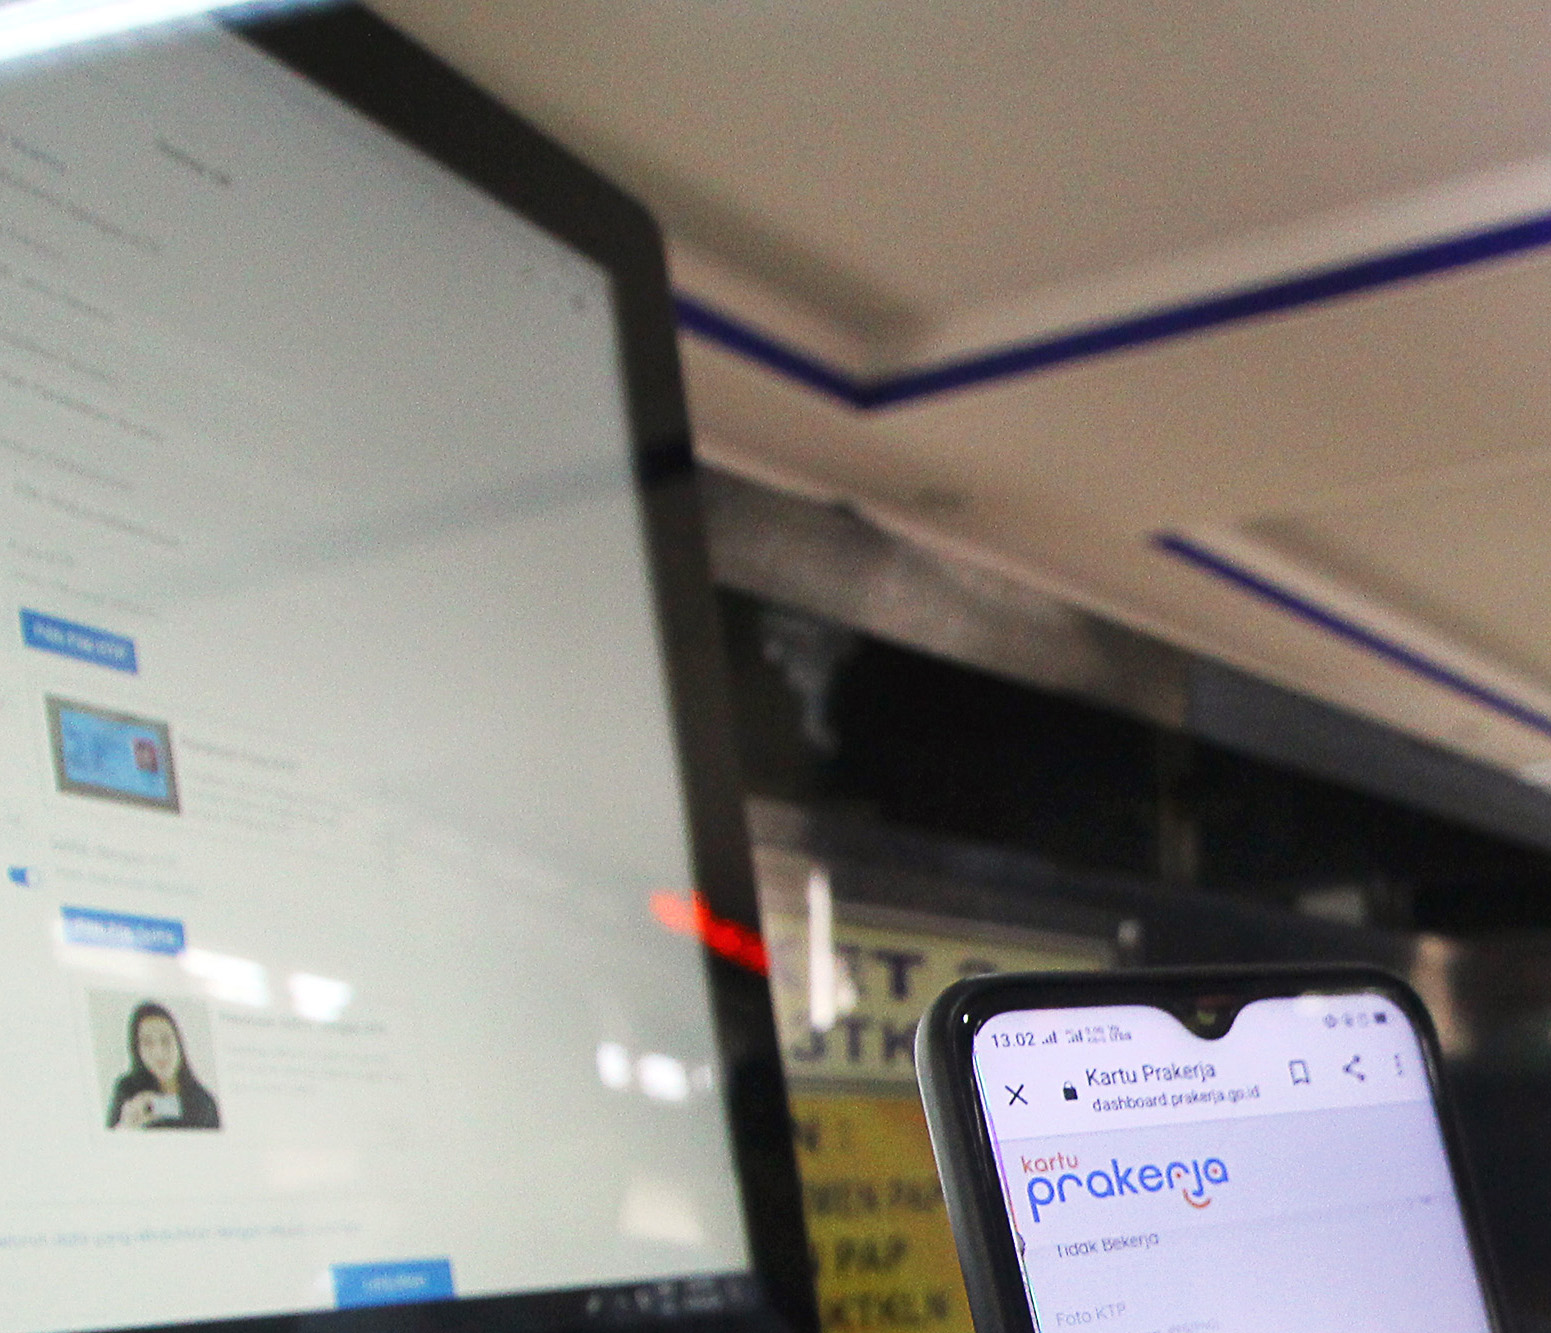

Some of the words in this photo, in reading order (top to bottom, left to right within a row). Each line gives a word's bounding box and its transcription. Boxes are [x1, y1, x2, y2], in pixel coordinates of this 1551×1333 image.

[991, 1032, 1035, 1048] 13.02
[1085, 1066, 1137, 1087] Kartu
[1142, 1062, 1216, 1083] Prakerja
[1092, 1084, 1261, 1112] dashboard.prakerja.go.id
[1021, 1152, 1079, 1174] kartu
[1027, 1158, 1230, 1223] prakerja
[1056, 1309, 1092, 1328] Foto
[1096, 1302, 1127, 1320] KTP
